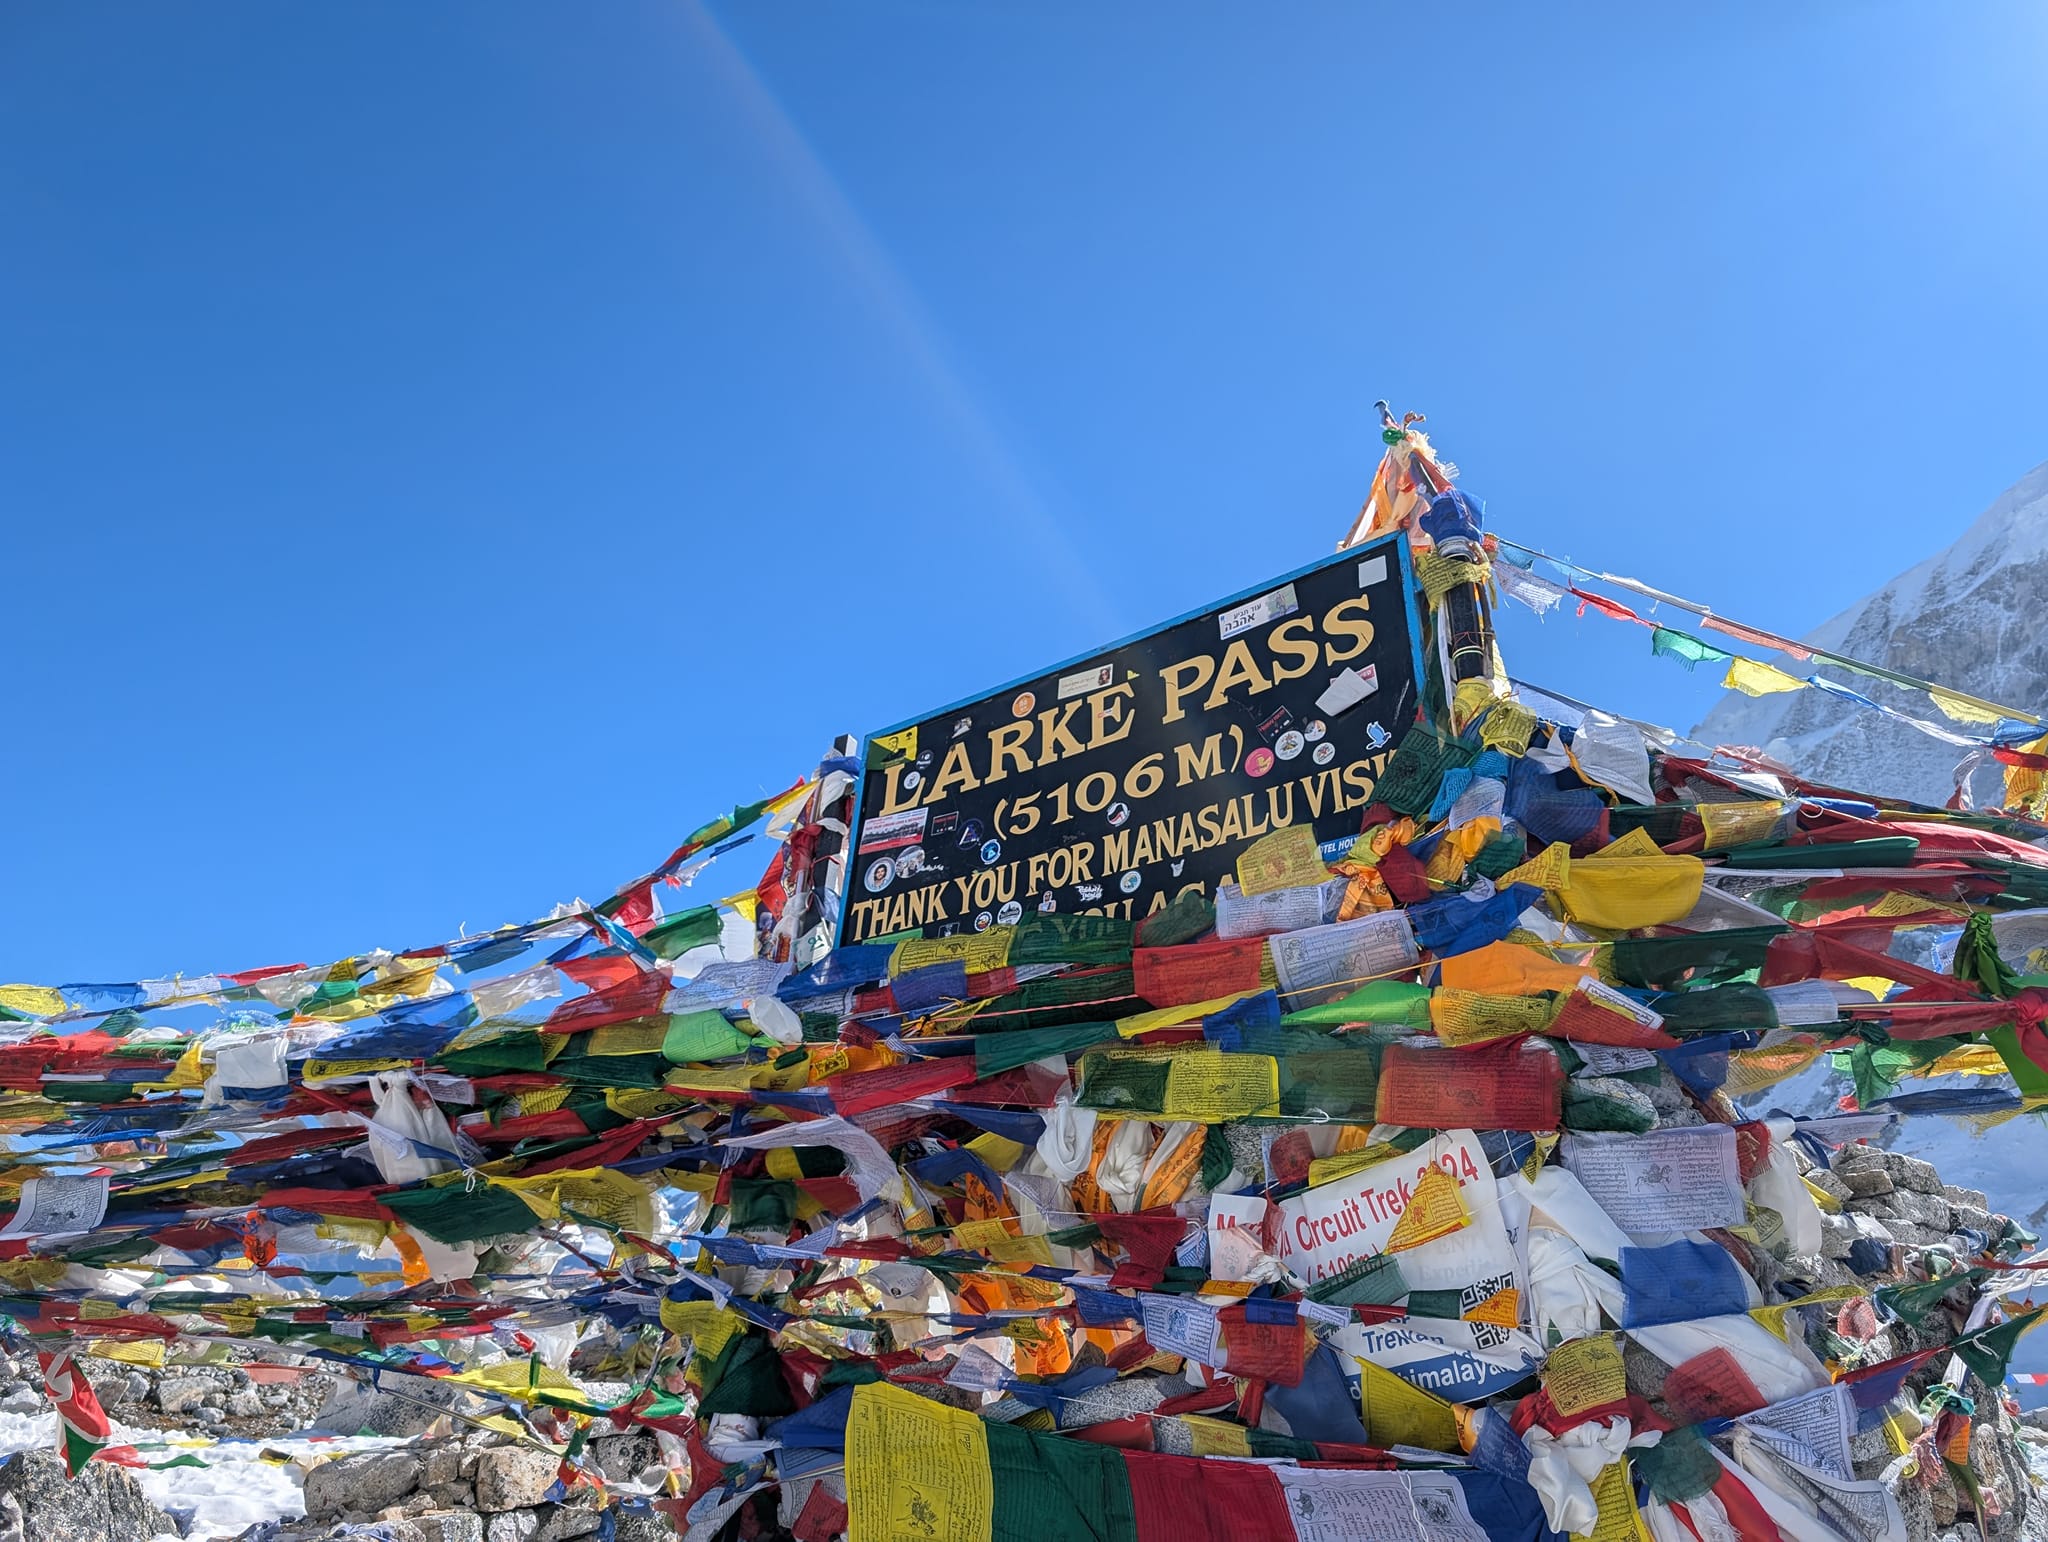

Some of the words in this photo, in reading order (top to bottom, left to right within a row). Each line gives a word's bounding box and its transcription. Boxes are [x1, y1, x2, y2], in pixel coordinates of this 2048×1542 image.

[879, 682, 1135, 816] LARKE
[1159, 594, 1374, 725] PASS
[851, 881, 949, 941] THANK
[954, 861, 1020, 915] YOU
[1025, 841, 1094, 897] FOR
[1101, 781, 1294, 877] MANASALU
[1361, 1178, 1411, 1223] Trek
[1414, 1146, 1479, 1193] 24
